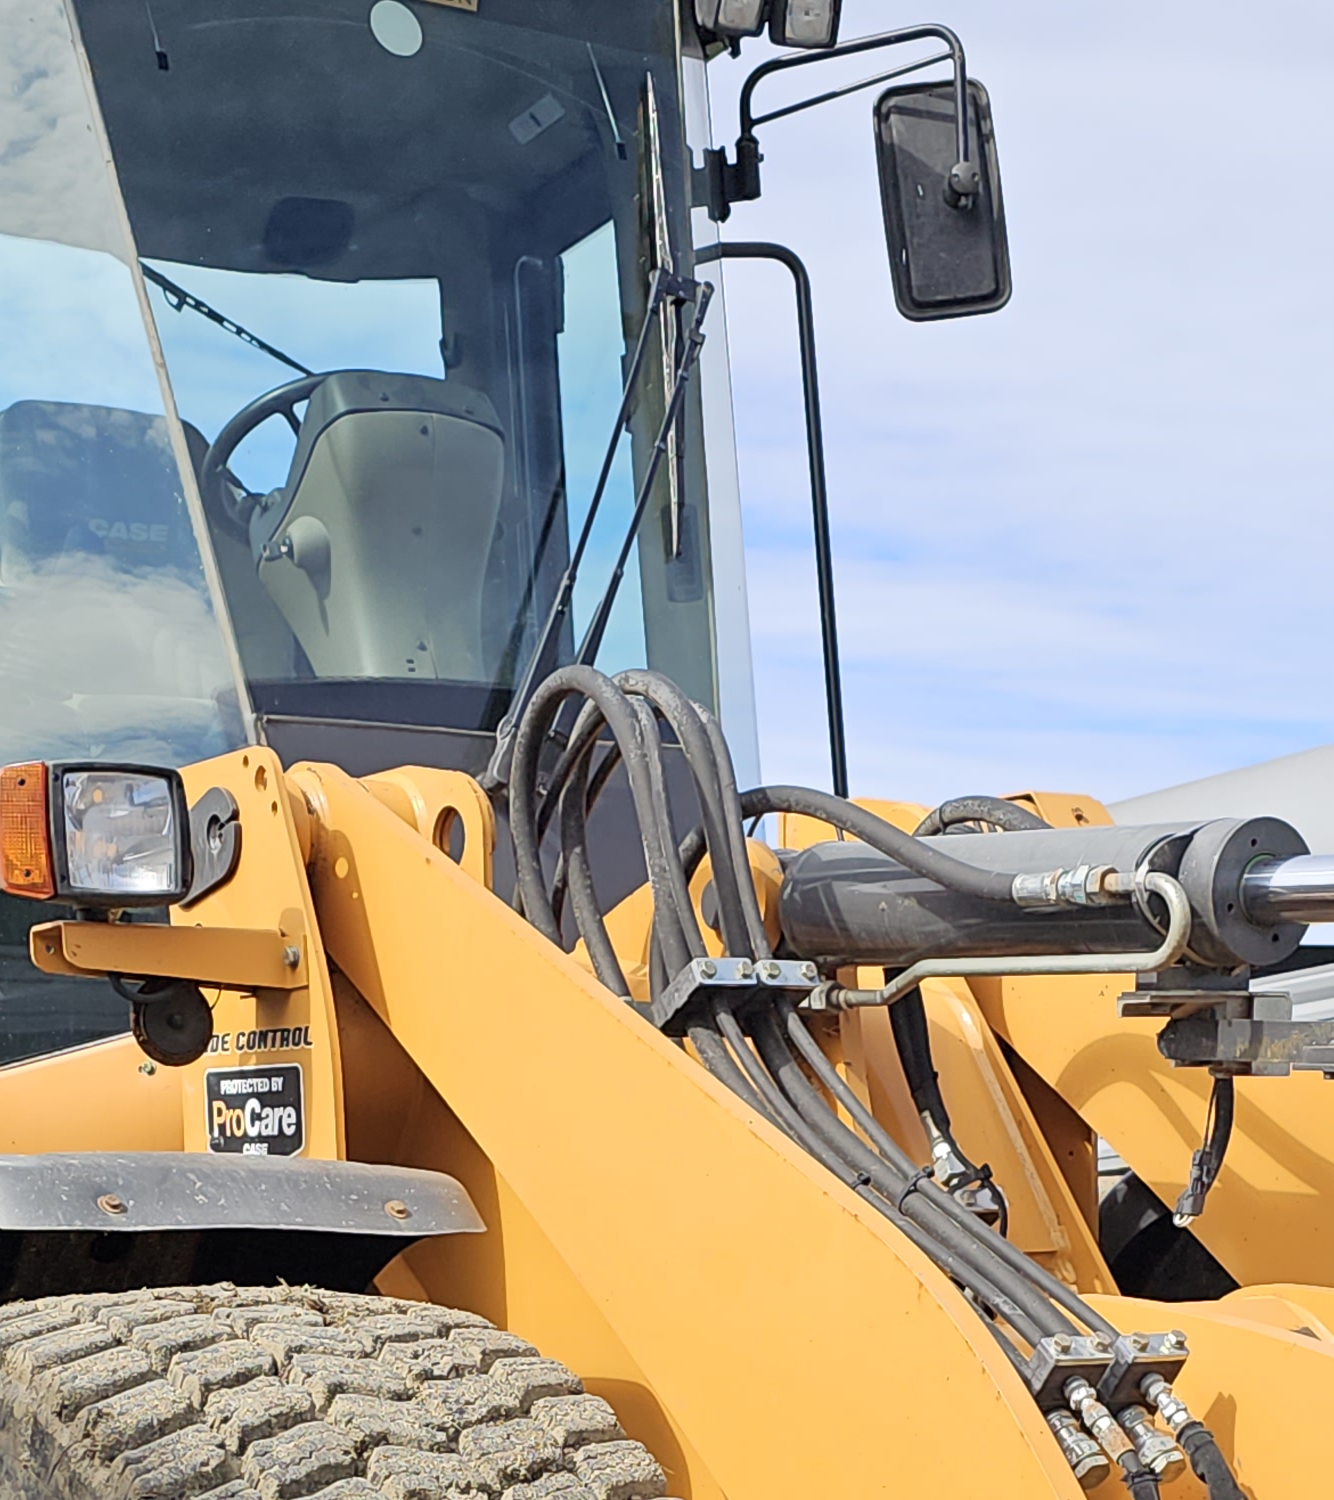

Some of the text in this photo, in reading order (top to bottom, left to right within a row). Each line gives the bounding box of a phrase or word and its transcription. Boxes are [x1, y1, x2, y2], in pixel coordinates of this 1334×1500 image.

[89, 518, 168, 541] CASE
[205, 1026, 313, 1053] DE CONTROL
[220, 1077, 284, 1095] PROTECTED BY
[212, 1098, 297, 1138] ProCare
[243, 1143, 269, 1155] CASE
